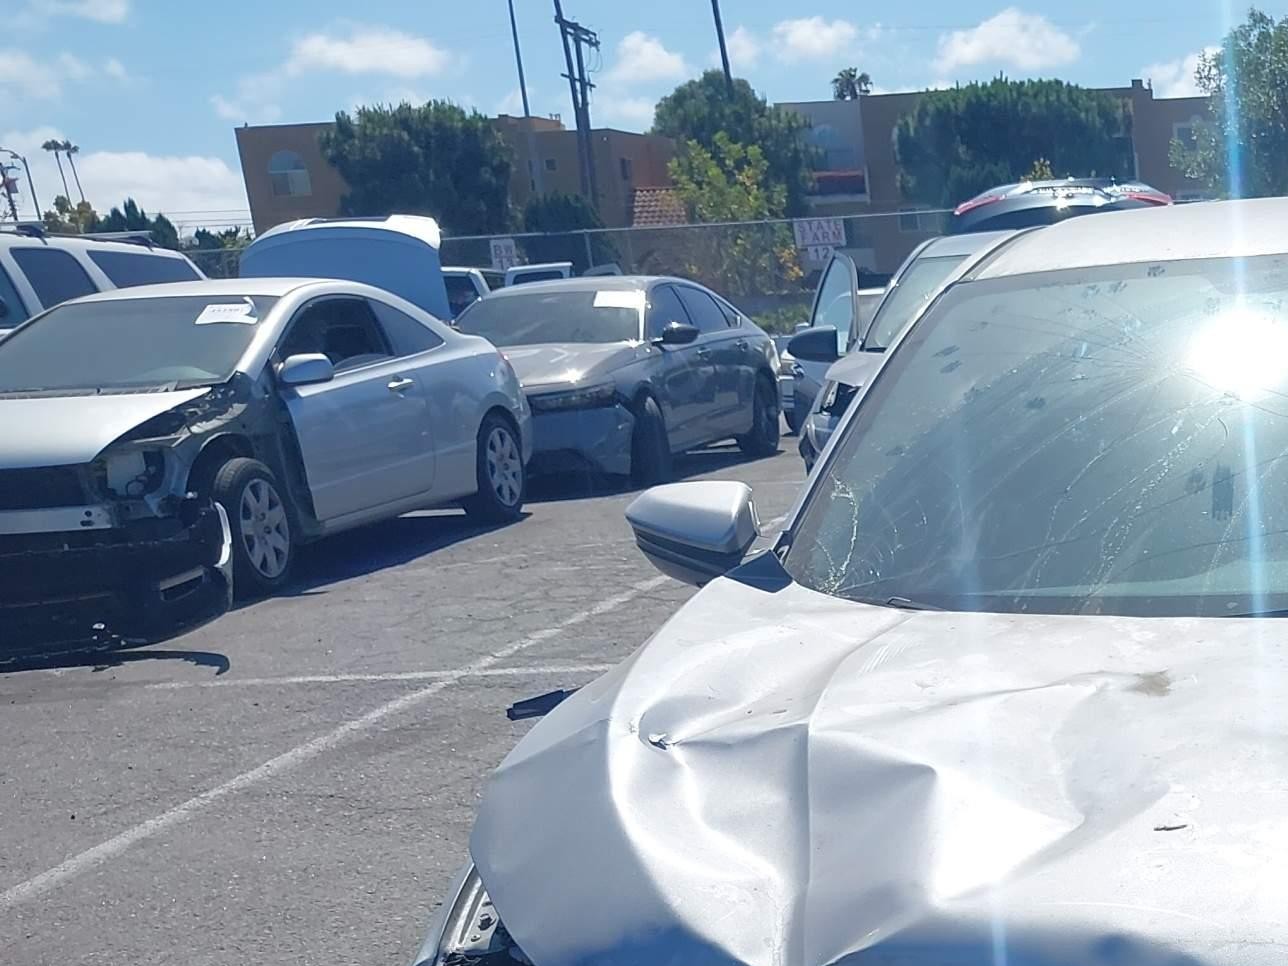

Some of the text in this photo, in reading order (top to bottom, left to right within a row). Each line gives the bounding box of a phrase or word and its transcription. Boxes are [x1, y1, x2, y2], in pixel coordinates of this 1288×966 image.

[798, 219, 842, 233] STATE
[800, 231, 843, 242] FARM
[813, 247, 830, 260] 12
